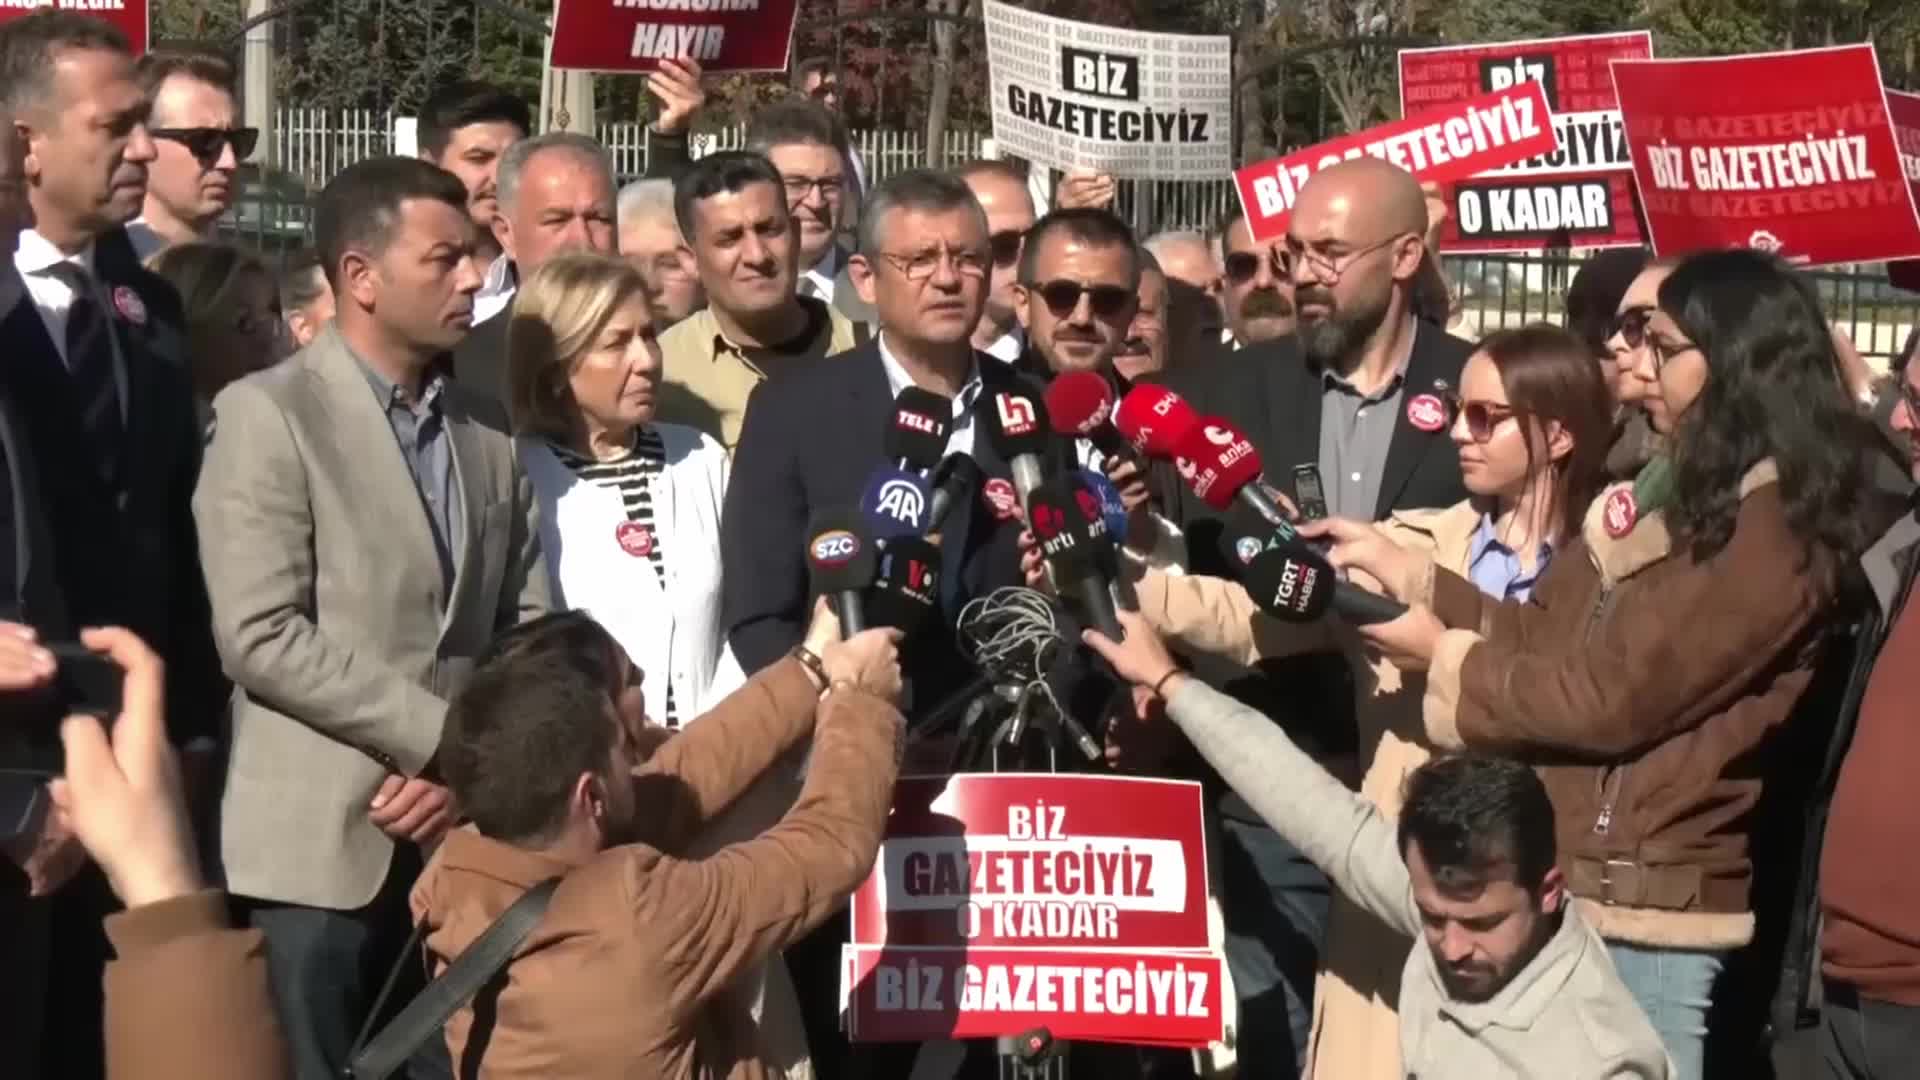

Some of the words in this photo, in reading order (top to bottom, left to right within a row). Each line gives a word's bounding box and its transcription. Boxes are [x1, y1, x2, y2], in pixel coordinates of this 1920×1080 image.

[631, 22, 724, 59] HAYIR
[1073, 53, 1128, 96] BİZ
[1007, 84, 1209, 142] GAZETECİYİZ
[1318, 95, 1542, 173] ETECİYİZ
[1647, 138, 1690, 190] BİZ
[1690, 128, 1877, 191] GAZETECİYİZ
[1458, 190, 1483, 233] O
[1488, 183, 1609, 232] KADAR
[899, 410, 933, 433] TELE
[936, 423, 944, 437] 1
[1219, 439, 1254, 466] anka
[875, 487, 918, 527] AA
[815, 537, 854, 560] SZC
[1272, 559, 1300, 607] TGRT
[1296, 567, 1319, 613] HABER
[1007, 799, 1067, 841] BİZ
[903, 844, 1155, 898] GAZETECİYİZ
[957, 902, 981, 939] O
[992, 900, 1120, 940] KADAR
[875, 957, 945, 1012] BİZ
[957, 960, 1210, 1018] GAZETECİYİZ
